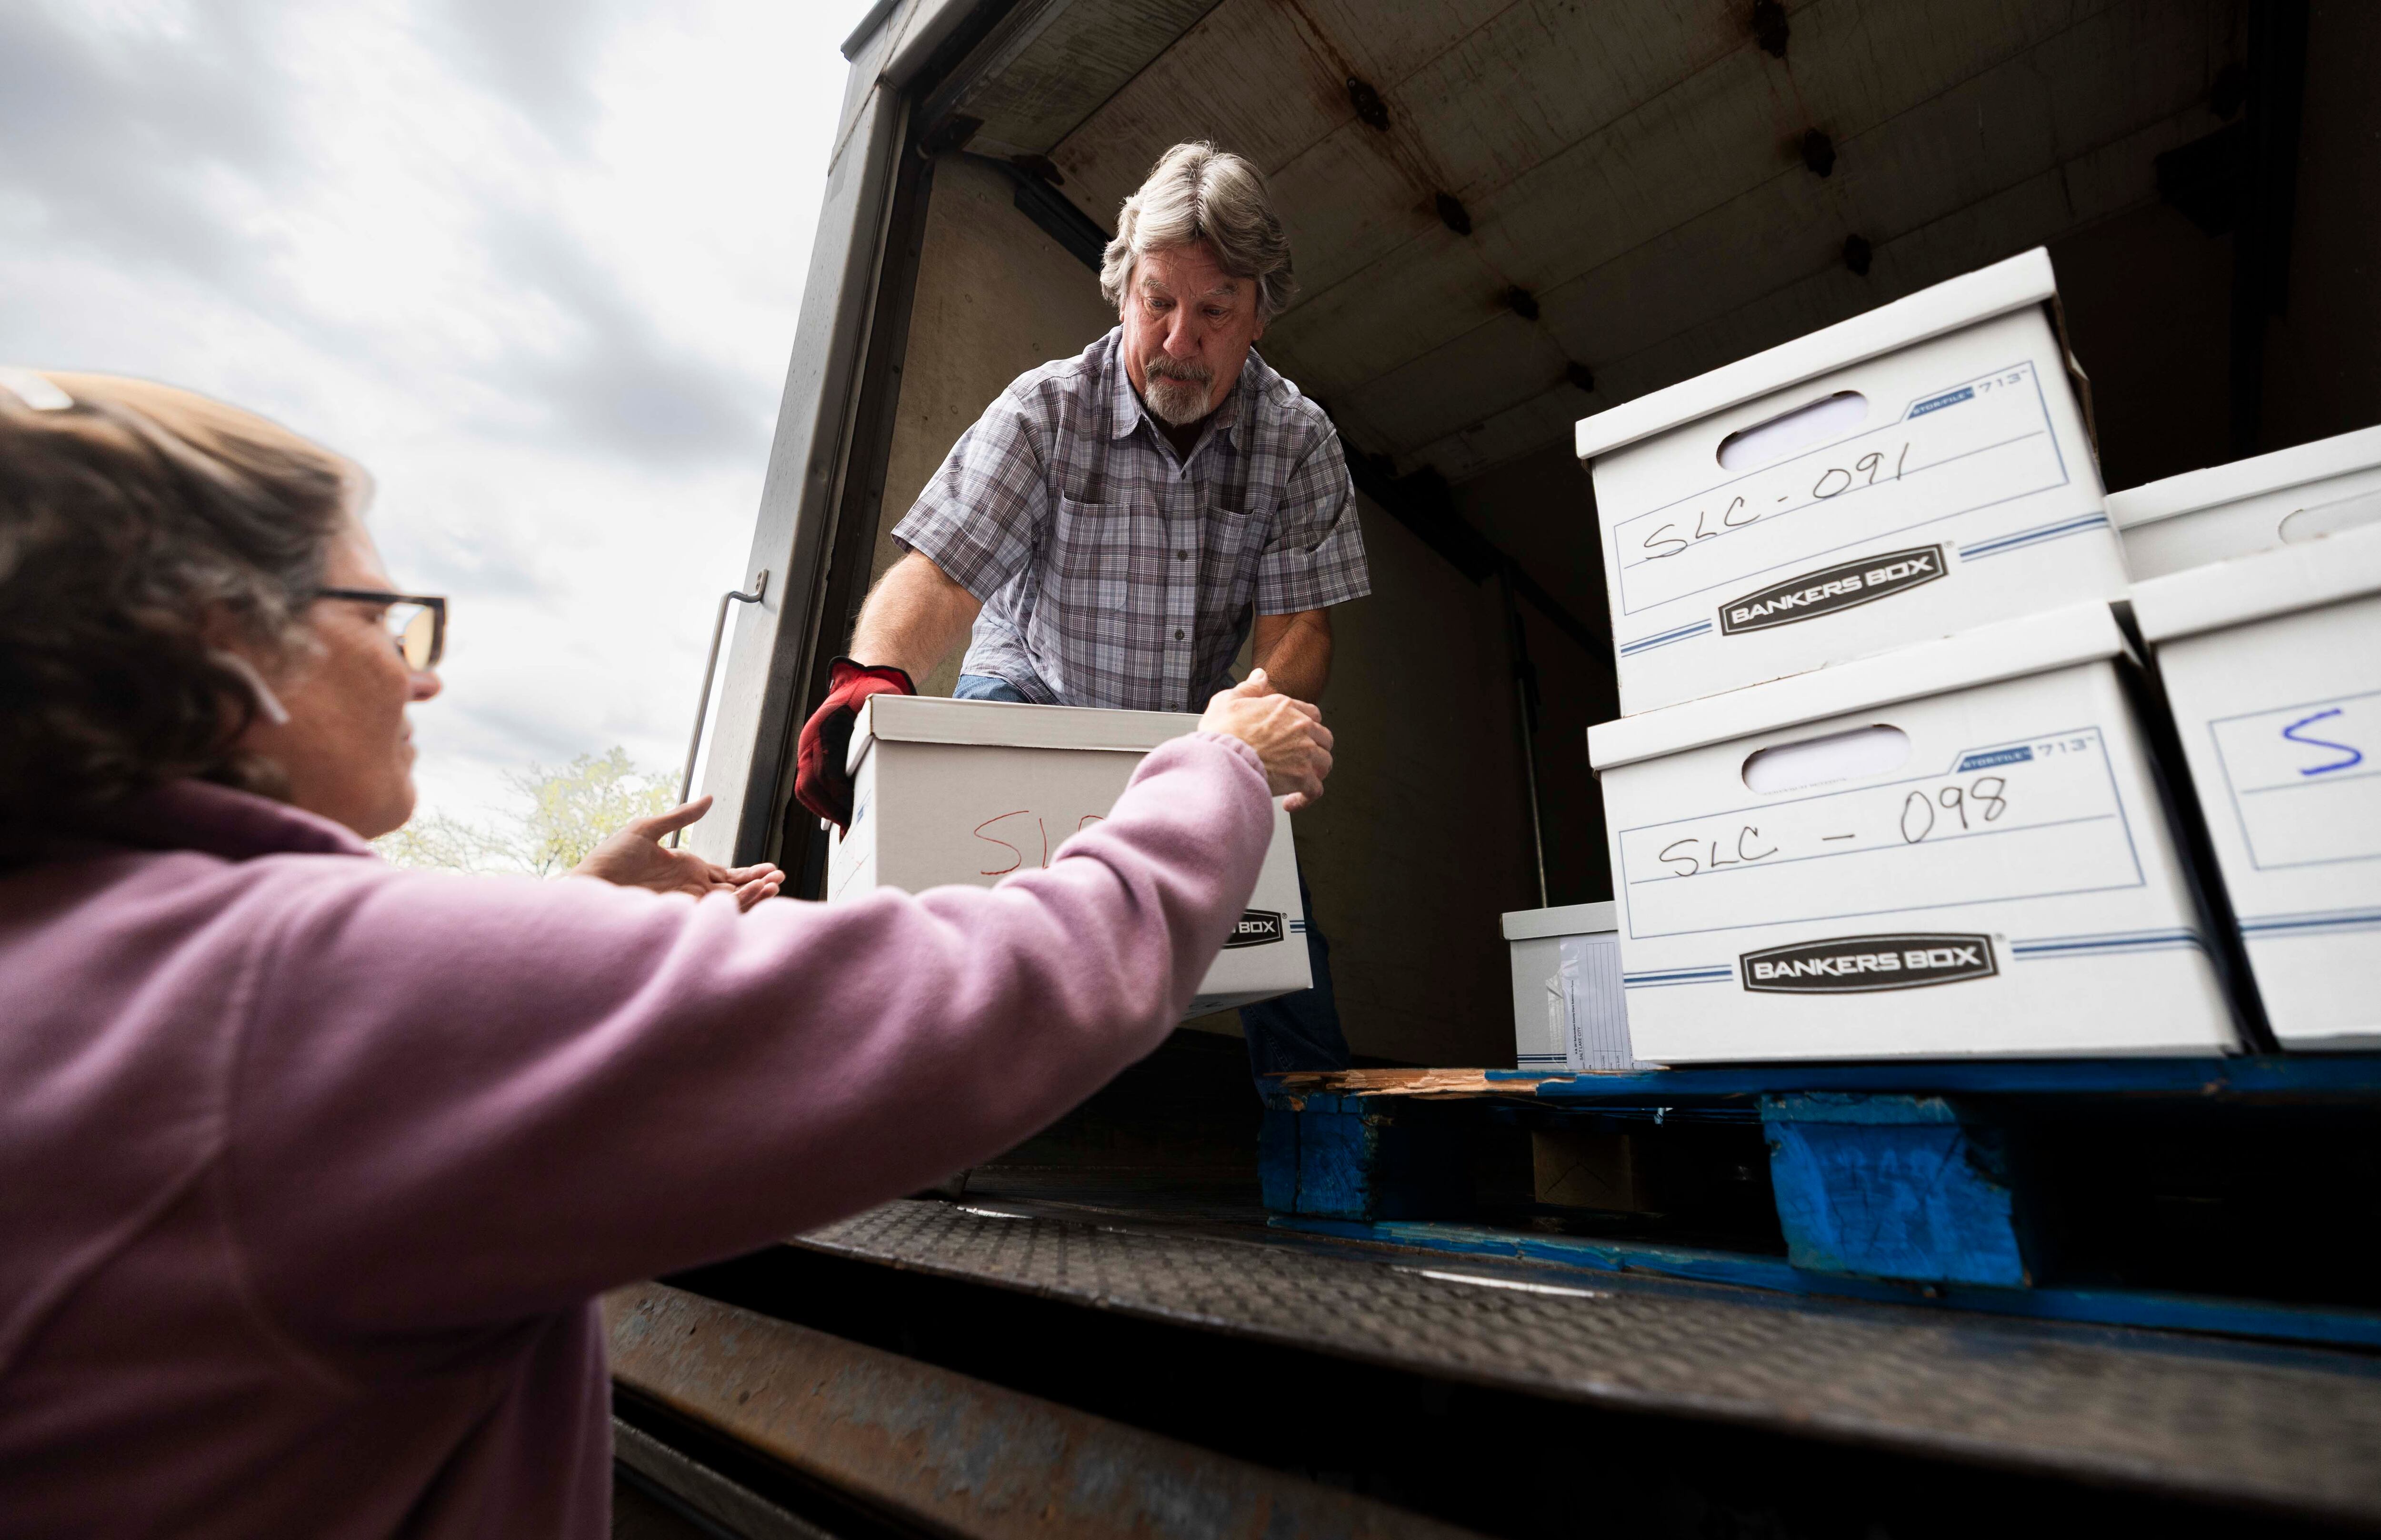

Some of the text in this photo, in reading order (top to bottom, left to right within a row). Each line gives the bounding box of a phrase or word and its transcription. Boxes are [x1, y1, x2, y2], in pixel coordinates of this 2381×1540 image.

[1731, 556, 1934, 624] BANKERS BOX
[1238, 920, 1276, 933] BOX
[1753, 946, 1982, 979] BANKERS BOX
